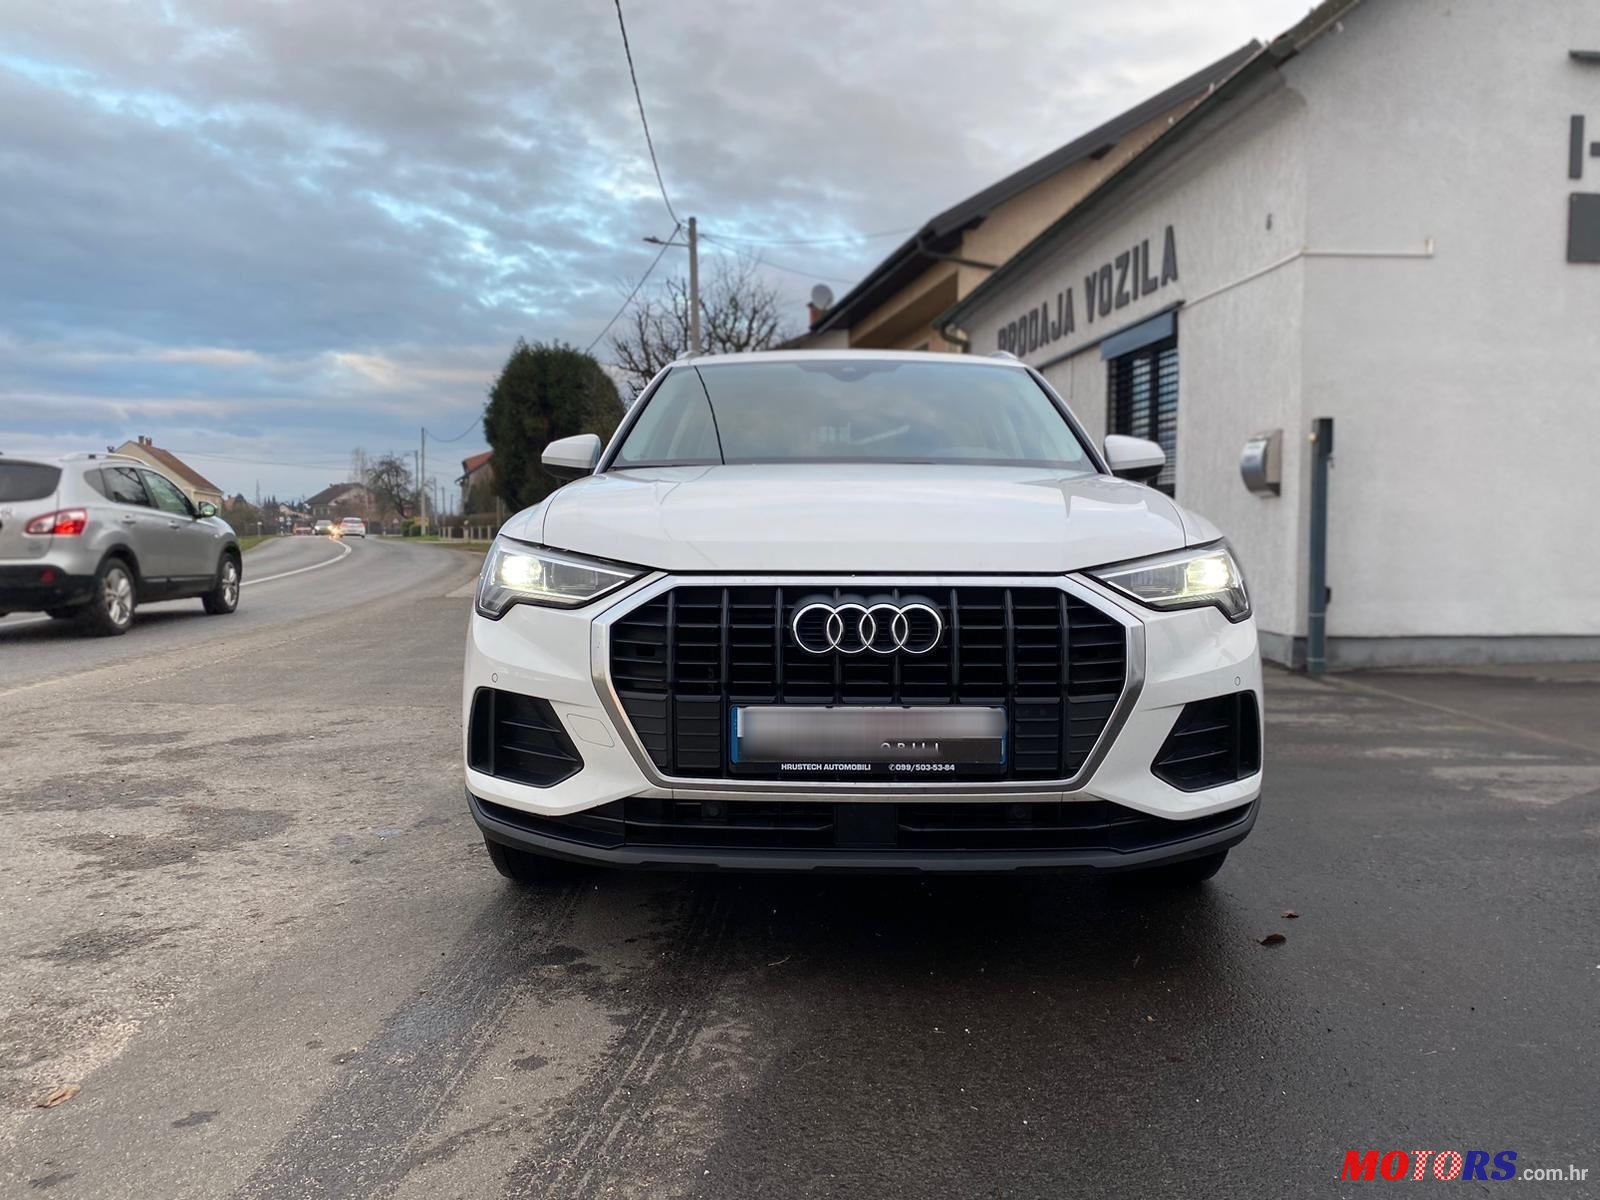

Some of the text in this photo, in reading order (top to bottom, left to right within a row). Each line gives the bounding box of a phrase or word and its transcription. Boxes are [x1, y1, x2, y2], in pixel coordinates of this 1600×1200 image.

[998, 224, 1178, 358] PRODAJA VOZILA
[781, 763, 823, 771] HRUSTECH
[823, 763, 872, 771] AUTOMOBILI
